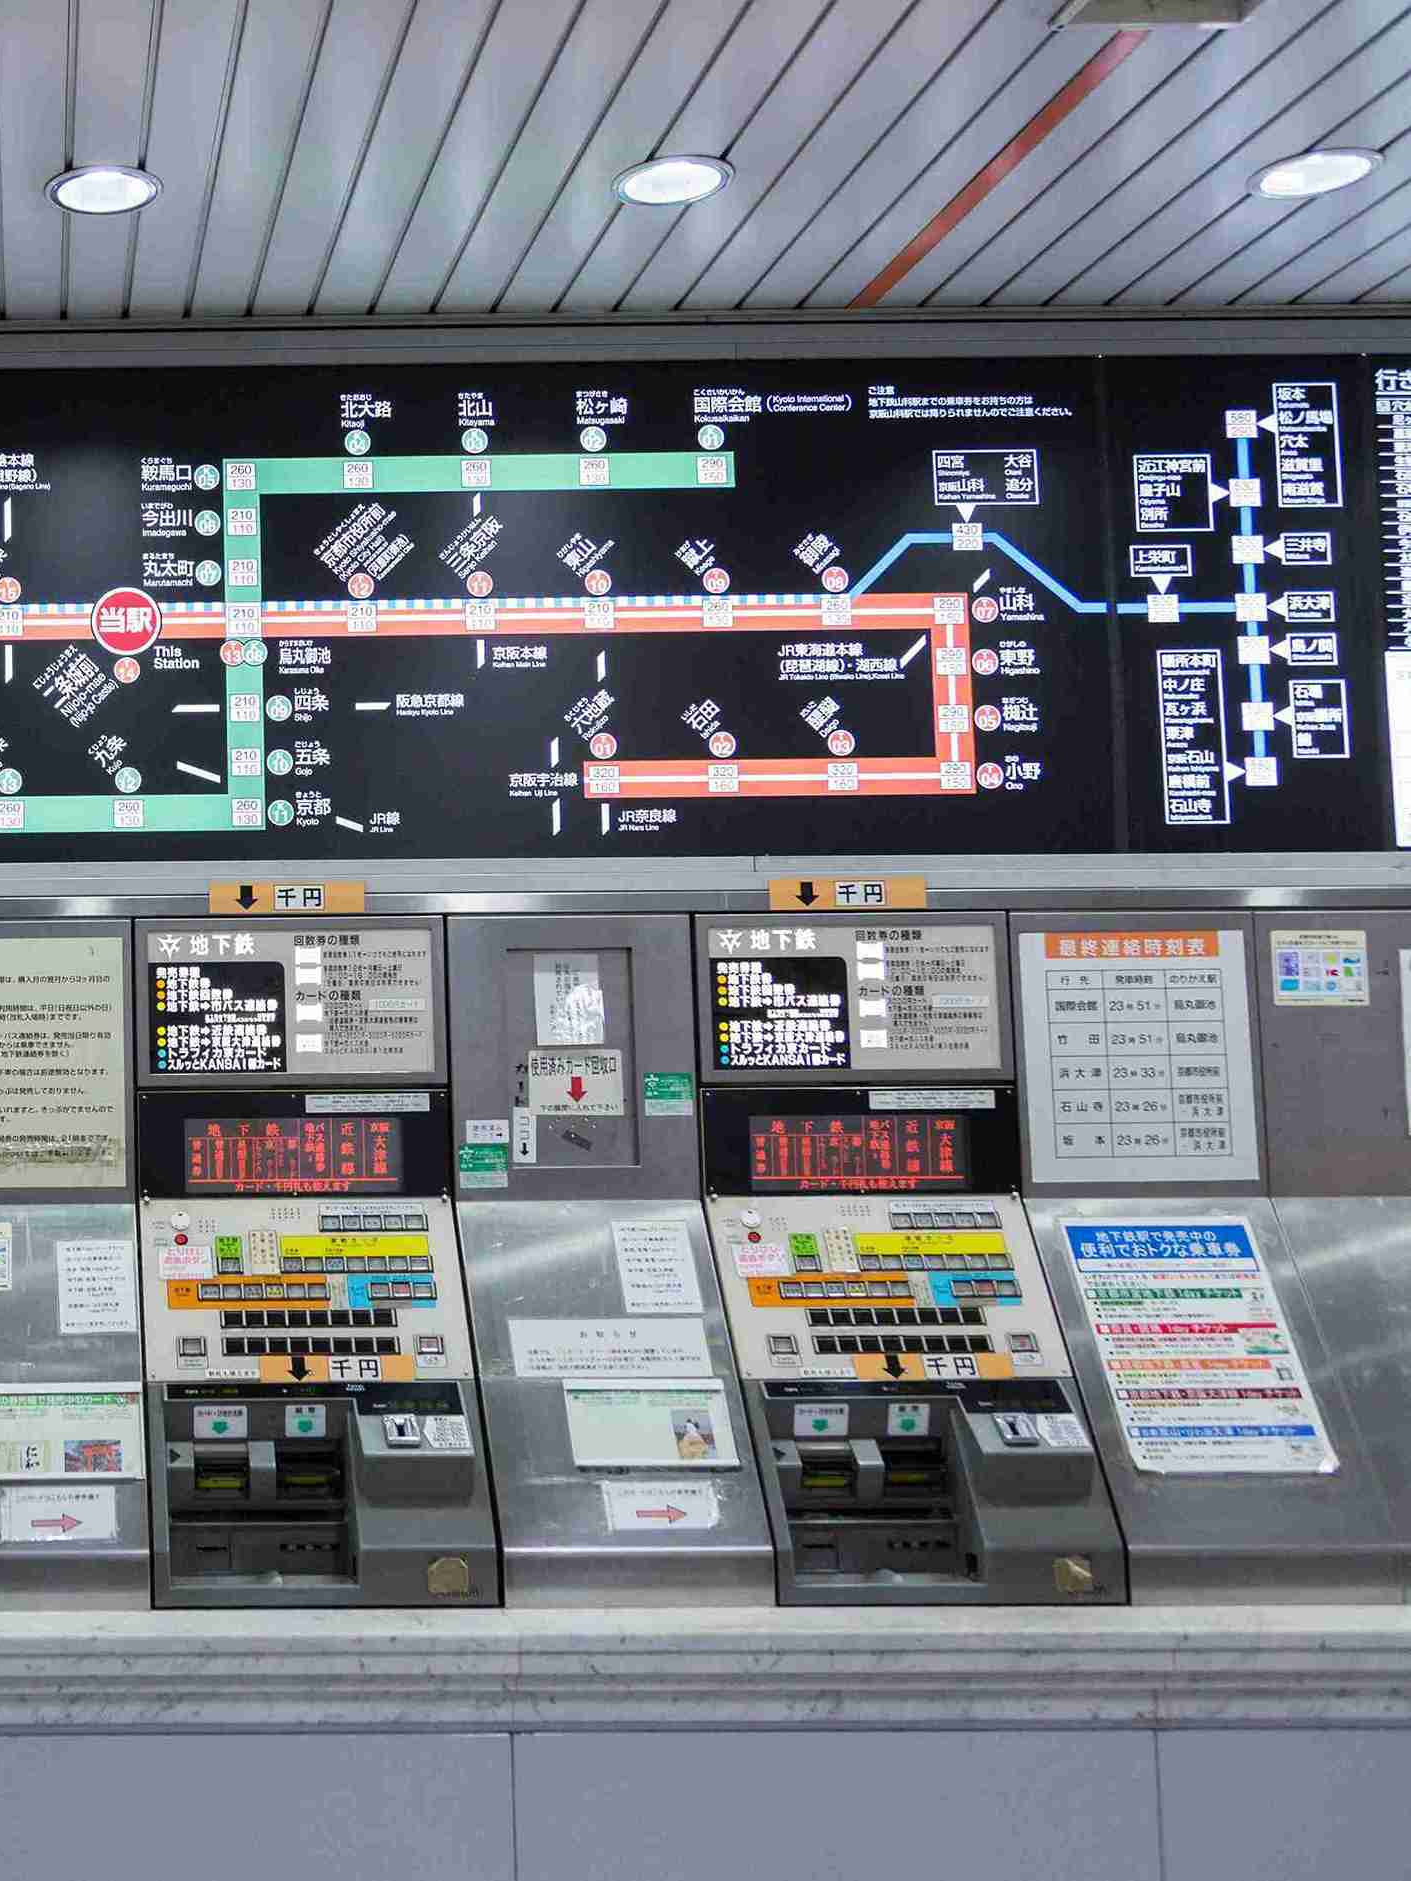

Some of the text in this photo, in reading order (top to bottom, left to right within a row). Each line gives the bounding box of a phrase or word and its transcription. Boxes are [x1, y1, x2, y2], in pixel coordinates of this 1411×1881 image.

[1277, 387, 1306, 400] 坂本
[340, 401, 392, 418] 北大路
[458, 399, 492, 416] 北山
[576, 398, 628, 416] 松ヶ崎
[693, 396, 762, 414] 国際会館
[348, 463, 369, 474] 260
[937, 455, 965, 468] 四宮
[1004, 455, 1032, 468] 大谷
[141, 464, 192, 482] 鞍馬口
[230, 464, 252, 475] 260
[1005, 478, 1034, 491] 追分
[142, 510, 193, 528] 今出川
[231, 510, 252, 521] 210
[143, 561, 194, 577] 丸太町
[232, 561, 254, 572] 210
[999, 594, 1034, 611] 山科
[99, 606, 154, 634] 当駅
[153, 646, 182, 658] This
[279, 648, 331, 665] 烏丸御池
[492, 646, 547, 660] 京阪本線
[999, 648, 1035, 666] 東野
[153, 657, 200, 670] Station
[235, 696, 257, 707] 210
[294, 695, 329, 712] 四条
[396, 694, 464, 708] 阪急京都線
[295, 749, 330, 766] 五条
[1005, 762, 1041, 780] 小野
[0, 803, 21, 814] 260
[296, 798, 332, 816] 京都
[1170, 799, 1212, 813] 石山寺
[236, 814, 258, 825] 130
[370, 812, 401, 826] JR線
[618, 809, 677, 824] JR奈良線
[277, 887, 322, 907] 千円
[838, 884, 883, 903] 千円
[190, 934, 256, 955] 地下鉄
[294, 935, 360, 946] 回数券の種類
[750, 929, 817, 950] 地下鉄
[295, 990, 362, 1001] カードの種類
[859, 985, 925, 997] カードの種類
[331, 1359, 379, 1379] 千円
[926, 1355, 977, 1377] 千円
